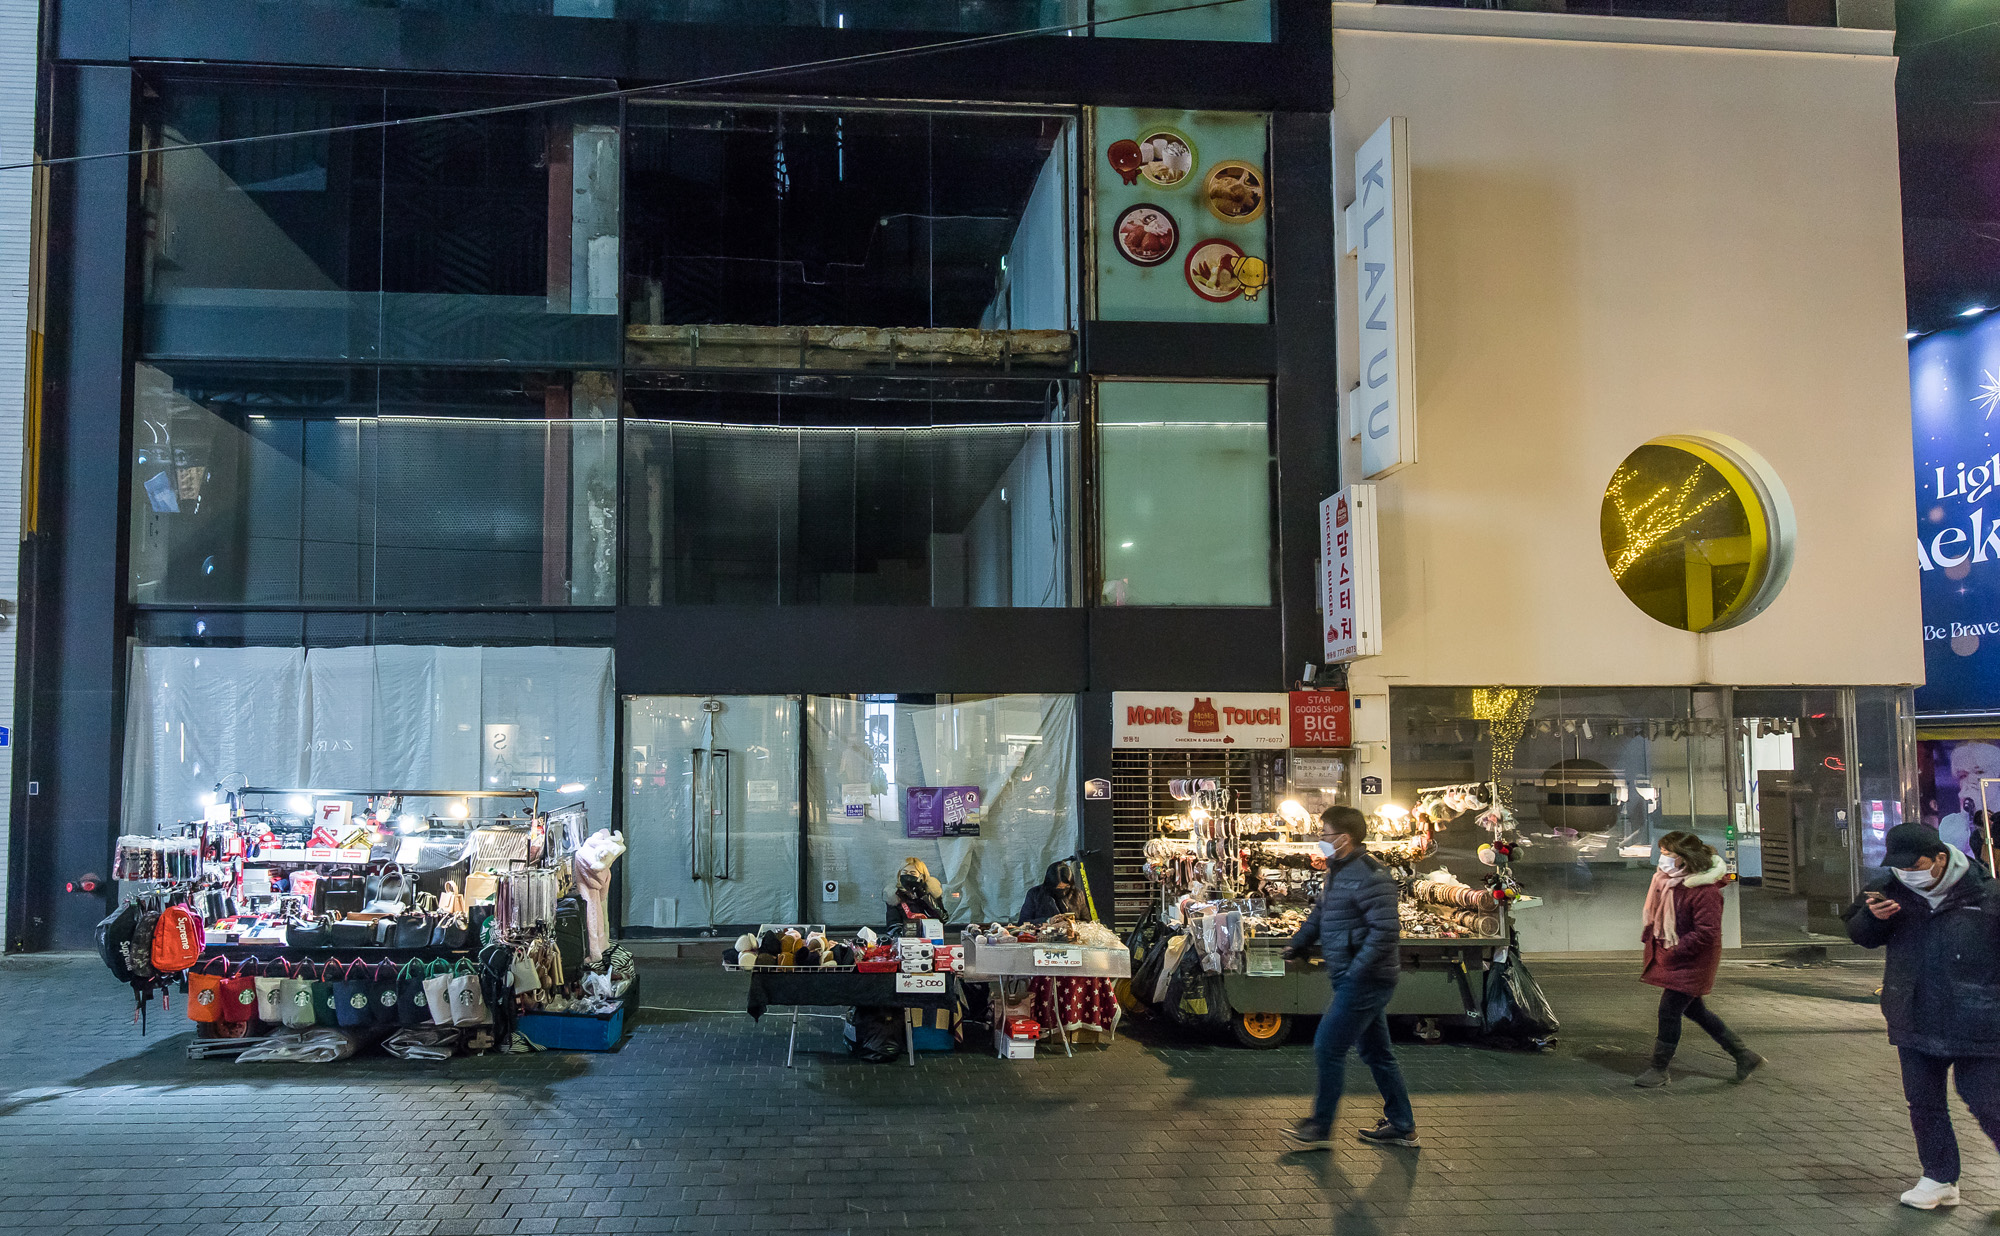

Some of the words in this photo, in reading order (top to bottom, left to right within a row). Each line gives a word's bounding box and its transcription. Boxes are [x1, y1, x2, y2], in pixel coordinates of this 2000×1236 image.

[1361, 157, 1390, 441] KLAVUU
[1336, 530, 1352, 640] 맘스터치
[1923, 625, 1947, 641] Be
[1336, 645, 1357, 658] 777-6073
[1307, 695, 1331, 704] STAR
[1222, 706, 1281, 726] TOUCH
[1295, 705, 1321, 714] GOODS
[1323, 705, 1344, 713] SHOP
[1304, 714, 1336, 730] BIG
[1305, 731, 1336, 742] SALE
[1092, 788, 1104, 797] 26
[1365, 785, 1376, 793] 24
[177, 916, 190, 950] Supreme
[119, 940, 132, 972] Supreme
